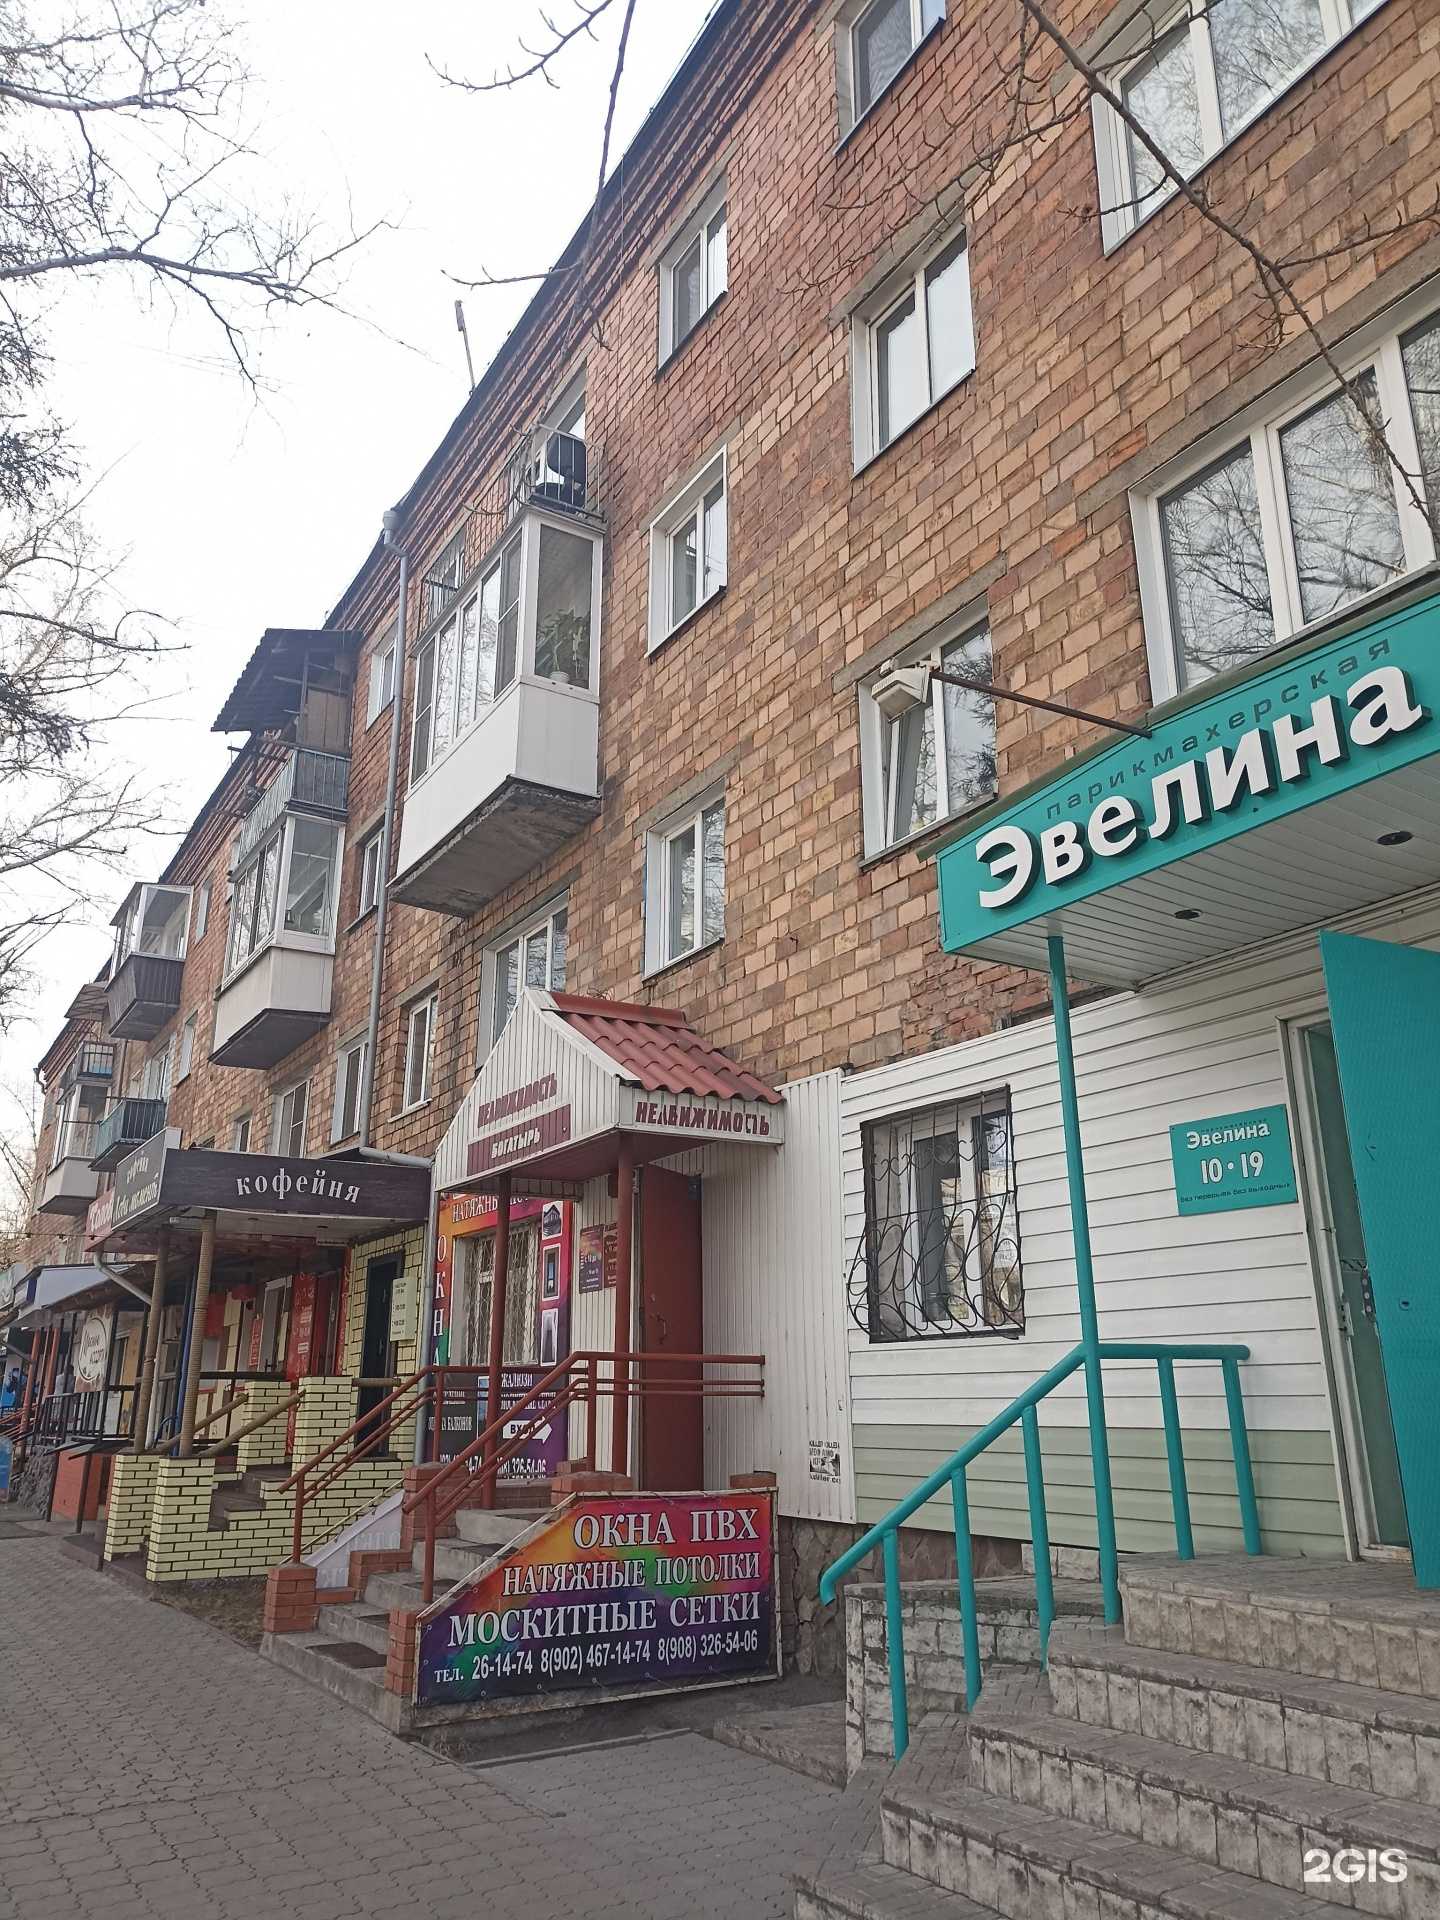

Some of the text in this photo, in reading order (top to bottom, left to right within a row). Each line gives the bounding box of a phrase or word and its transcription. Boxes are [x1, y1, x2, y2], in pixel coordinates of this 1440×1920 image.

[1047, 637, 1390, 819] парикмахерская
[975, 665, 1425, 909] Эвелина
[478, 1073, 557, 1128] НЕДВИЖИМОСТЬ
[635, 1101, 770, 1136] НЕДВИЖИМОСТЬ
[491, 1128, 541, 1159] БОГАТЫРЬ
[1186, 1123, 1270, 1149] Эвелина
[236, 1168, 361, 1203] кофейня
[573, 1509, 759, 1549] ОКНА ПВХ
[502, 1552, 760, 1596] НАТЯЖНЫЕ ПОТОЛКИ
[447, 1592, 760, 1647] МОСКИТНЫЕ СЕТКИ
[472, 1650, 533, 1681] 26-14-74
[540, 1645, 582, 1677] 8(902)
[586, 1640, 650, 1669] 467-14-74
[658, 1635, 697, 1665] 8(908)
[700, 1630, 758, 1656] 326-54-06
